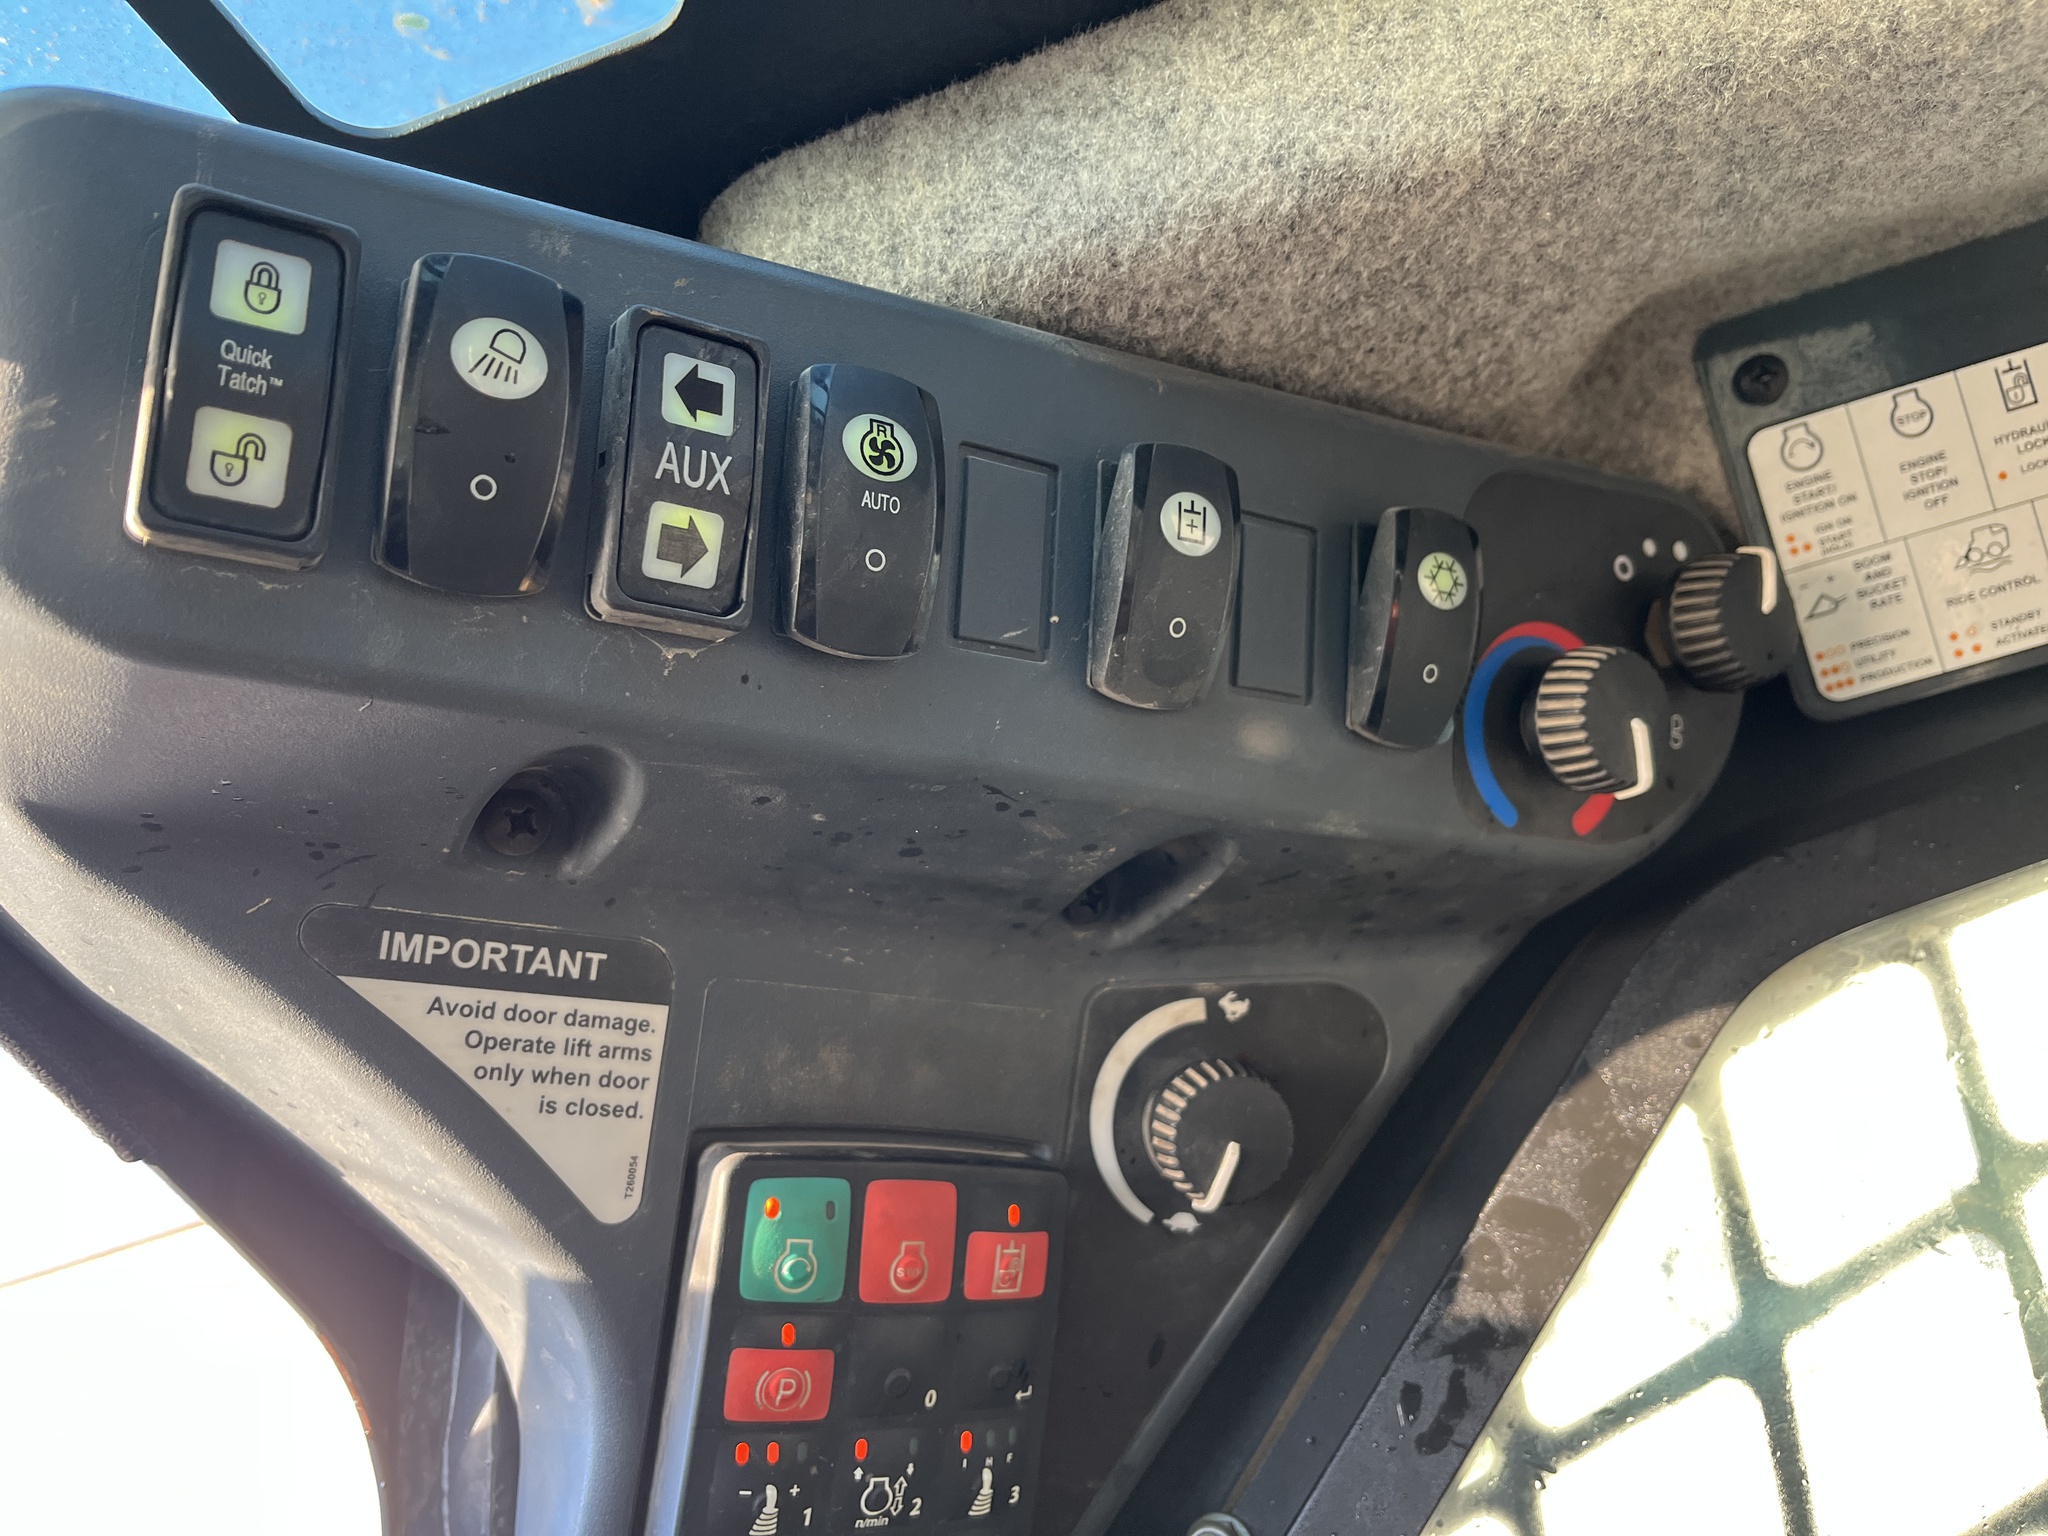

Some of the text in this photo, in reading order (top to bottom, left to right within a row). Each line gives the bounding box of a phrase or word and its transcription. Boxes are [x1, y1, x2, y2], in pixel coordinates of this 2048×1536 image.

[219, 339, 273, 371] Quick
[1897, 410, 1927, 426] STOP
[877, 422, 886, 439] R
[655, 441, 732, 496] AUX
[1900, 450, 1947, 473] ENGINE
[1785, 469, 1832, 492] ENGINE
[1903, 477, 1959, 500] IGNITION
[861, 489, 900, 514] AUTO
[1781, 492, 1857, 523] IGNITION ON
[1924, 495, 1948, 510] OFF
[1853, 551, 1891, 571] BOOM
[1865, 565, 1892, 581] AND
[1856, 576, 1907, 599] BUCKET
[1946, 574, 2041, 609] RIDE CONTROL
[1870, 593, 1903, 611] RATE
[1991, 608, 2041, 630] STANDBY
[1850, 628, 1910, 650] PRECISION
[1854, 649, 1896, 668] UTILITY
[1860, 656, 1933, 681] PRODUCTION
[379, 930, 607, 981] IMPORTANT
[427, 996, 656, 1036] Avoid door damage.
[465, 1030, 653, 1062] Operate lift arms
[474, 1063, 650, 1091] only when door
[538, 1096, 644, 1119] is closed.
[624, 1155, 639, 1199] T260054
[775, 1378, 797, 1406] P
[1008, 1485, 1021, 1504] 3
[803, 1508, 812, 1526] 1
[909, 1498, 922, 1516] 2
[854, 1516, 889, 1528] n/min
